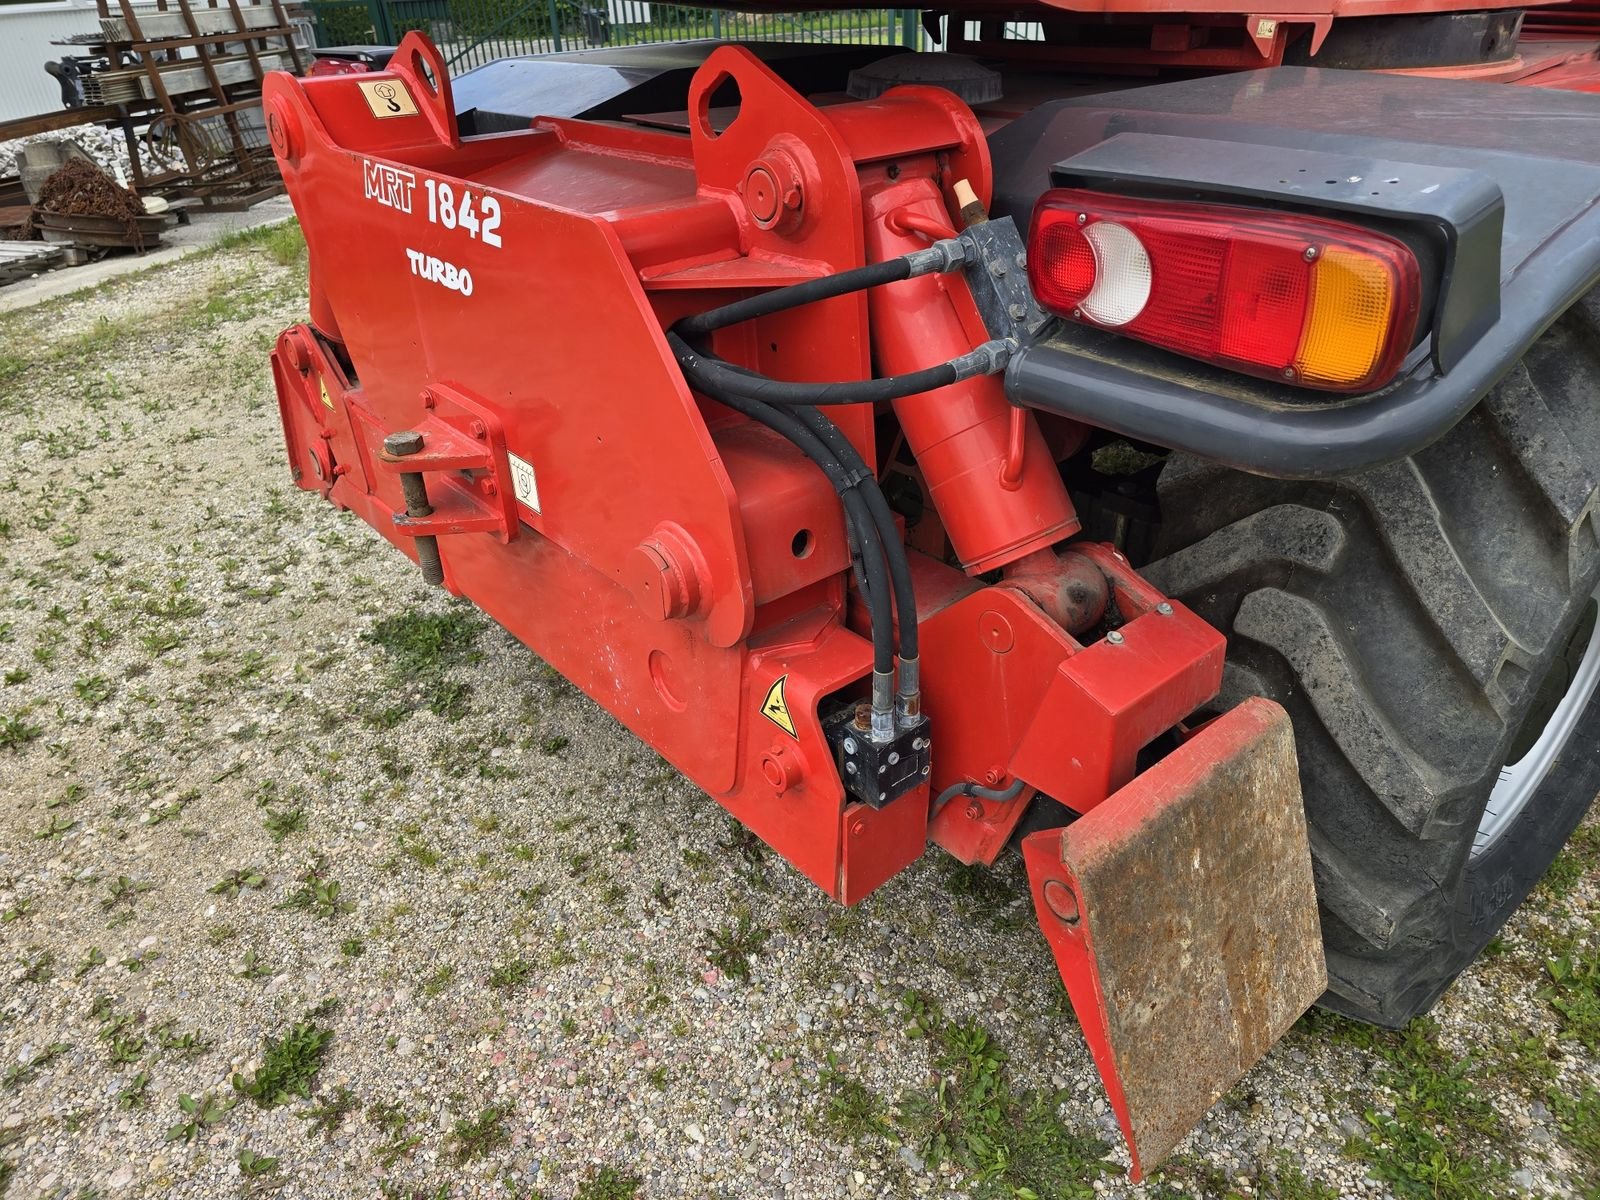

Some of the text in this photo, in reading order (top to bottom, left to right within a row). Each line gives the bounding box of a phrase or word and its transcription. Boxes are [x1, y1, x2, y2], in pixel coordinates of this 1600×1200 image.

[364, 160, 502, 248] MRT 1842
[406, 247, 473, 296] TURBO
